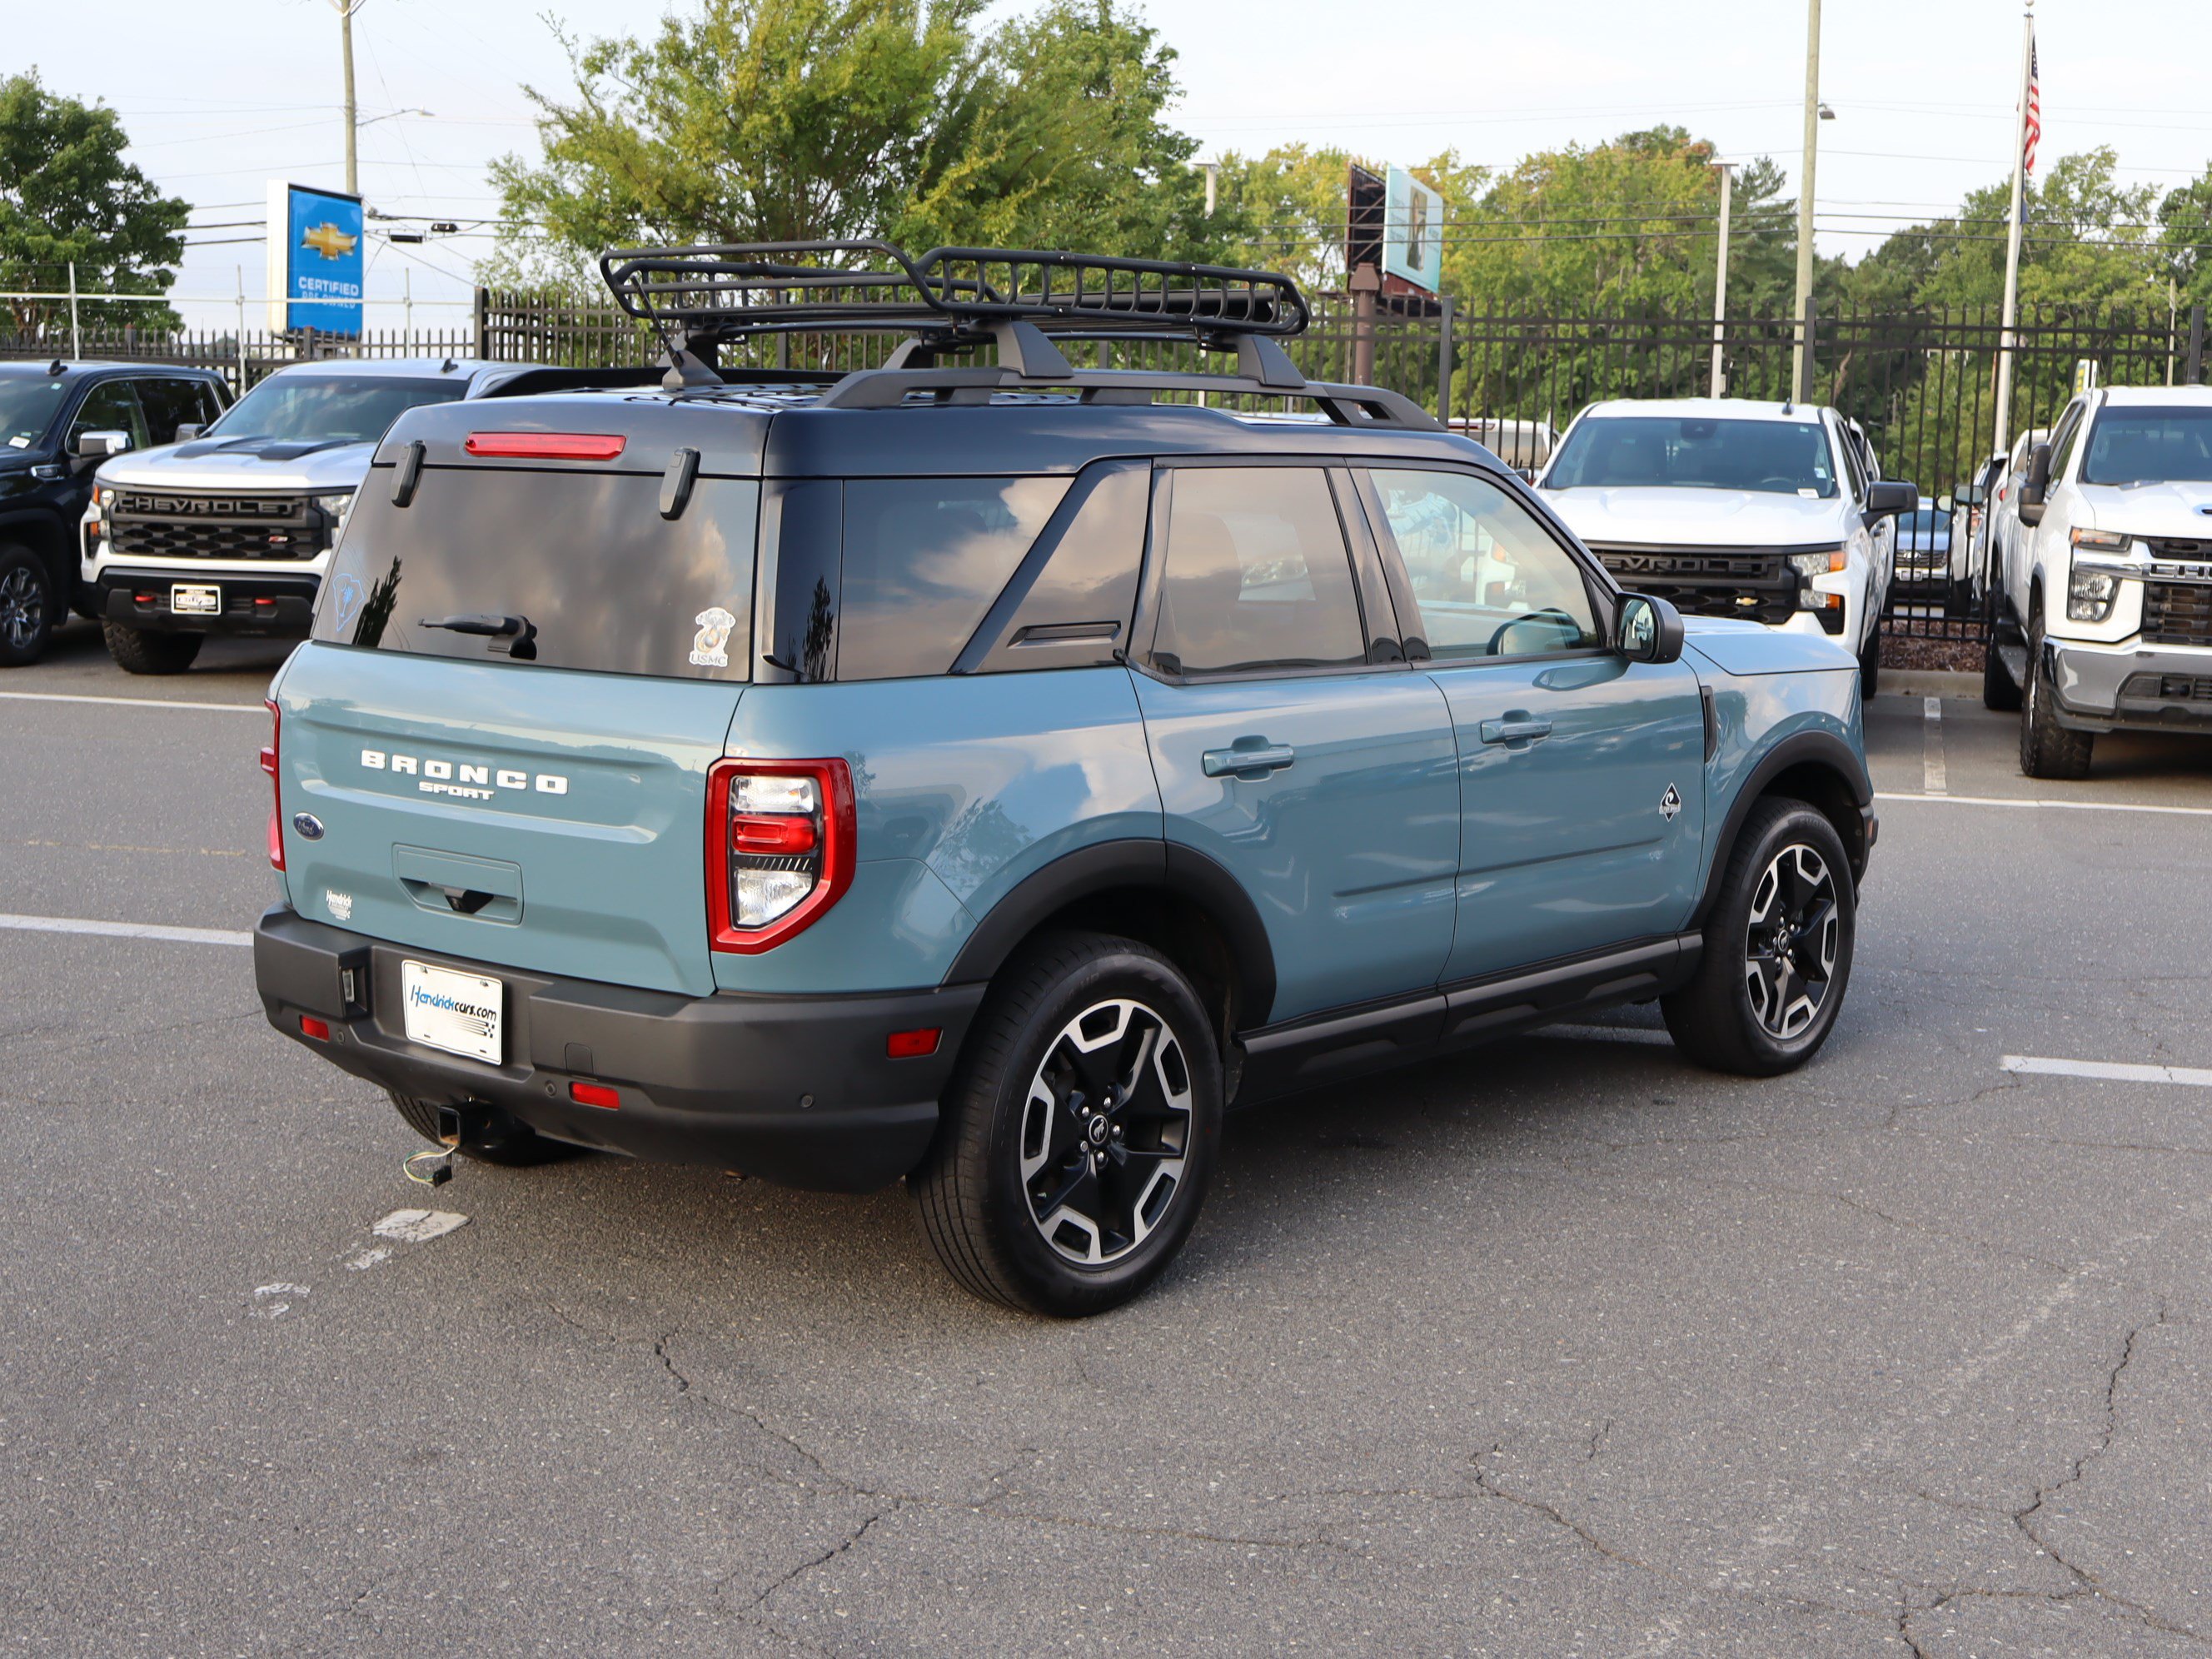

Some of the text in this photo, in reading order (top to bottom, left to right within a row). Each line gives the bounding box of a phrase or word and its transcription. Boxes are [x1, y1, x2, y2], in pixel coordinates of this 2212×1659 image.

[298, 276, 359, 296] CERTIFIED
[118, 496, 300, 516] CHEVROLET
[1598, 555, 1778, 574] EVROLET
[691, 653, 726, 665] USMC
[361, 750, 568, 795] BRONCO
[418, 780, 495, 800] SPORT
[326, 889, 352, 909] Hendrick
[411, 984, 497, 1022] Hendrickcars.com
